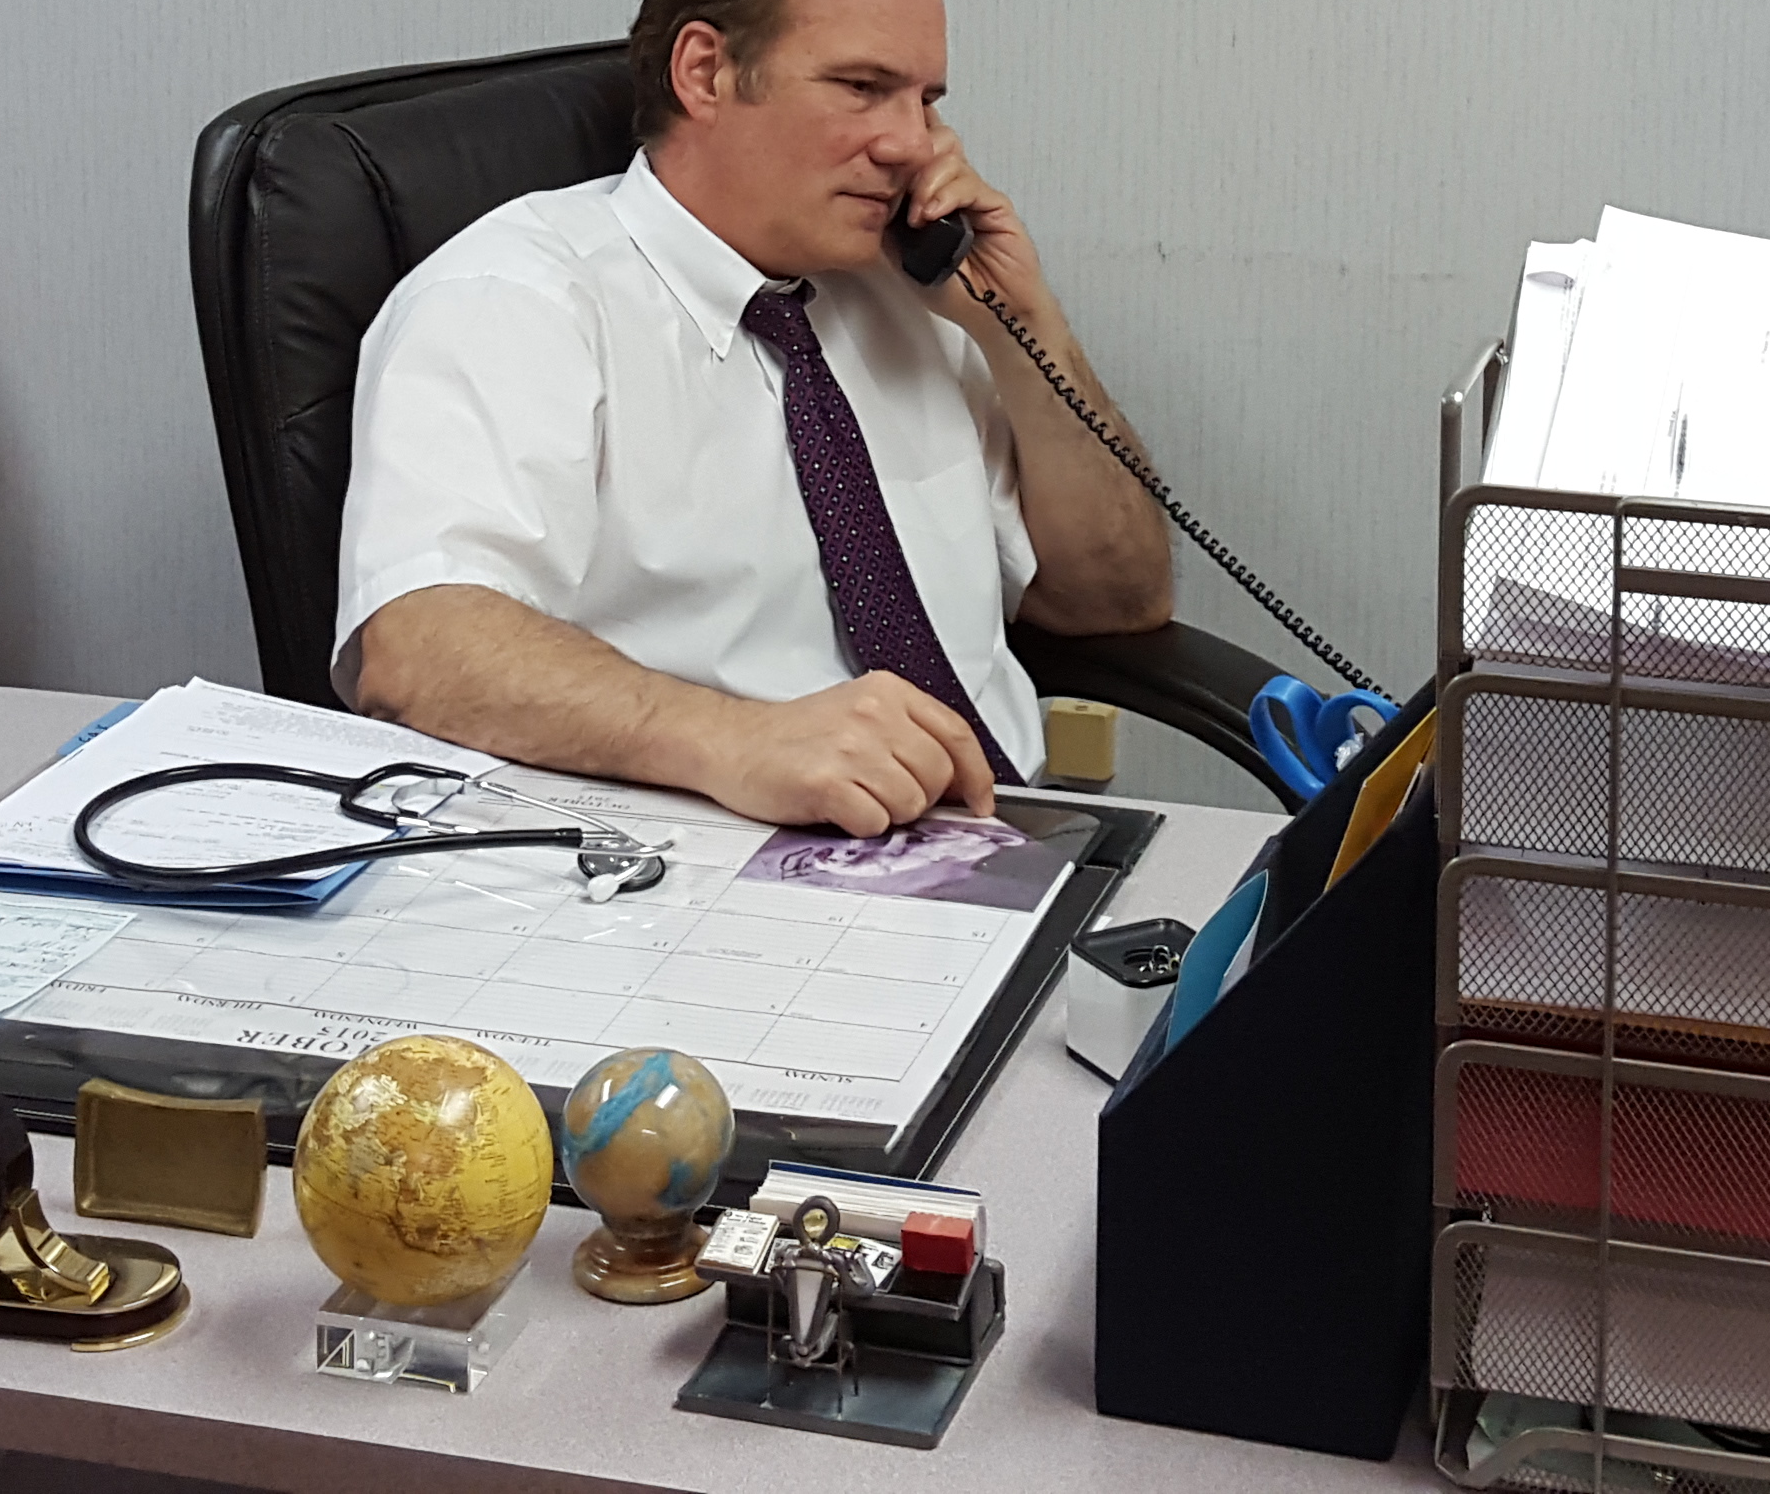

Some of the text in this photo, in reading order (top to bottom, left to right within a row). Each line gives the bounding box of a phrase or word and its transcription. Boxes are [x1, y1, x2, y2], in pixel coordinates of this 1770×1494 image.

[178, 993, 263, 1010] THURSDAY
[314, 1009, 418, 1030] WEDNESDAY
[476, 1029, 552, 1047] TUESDAY
[784, 1069, 852, 1084] SUNDAY
